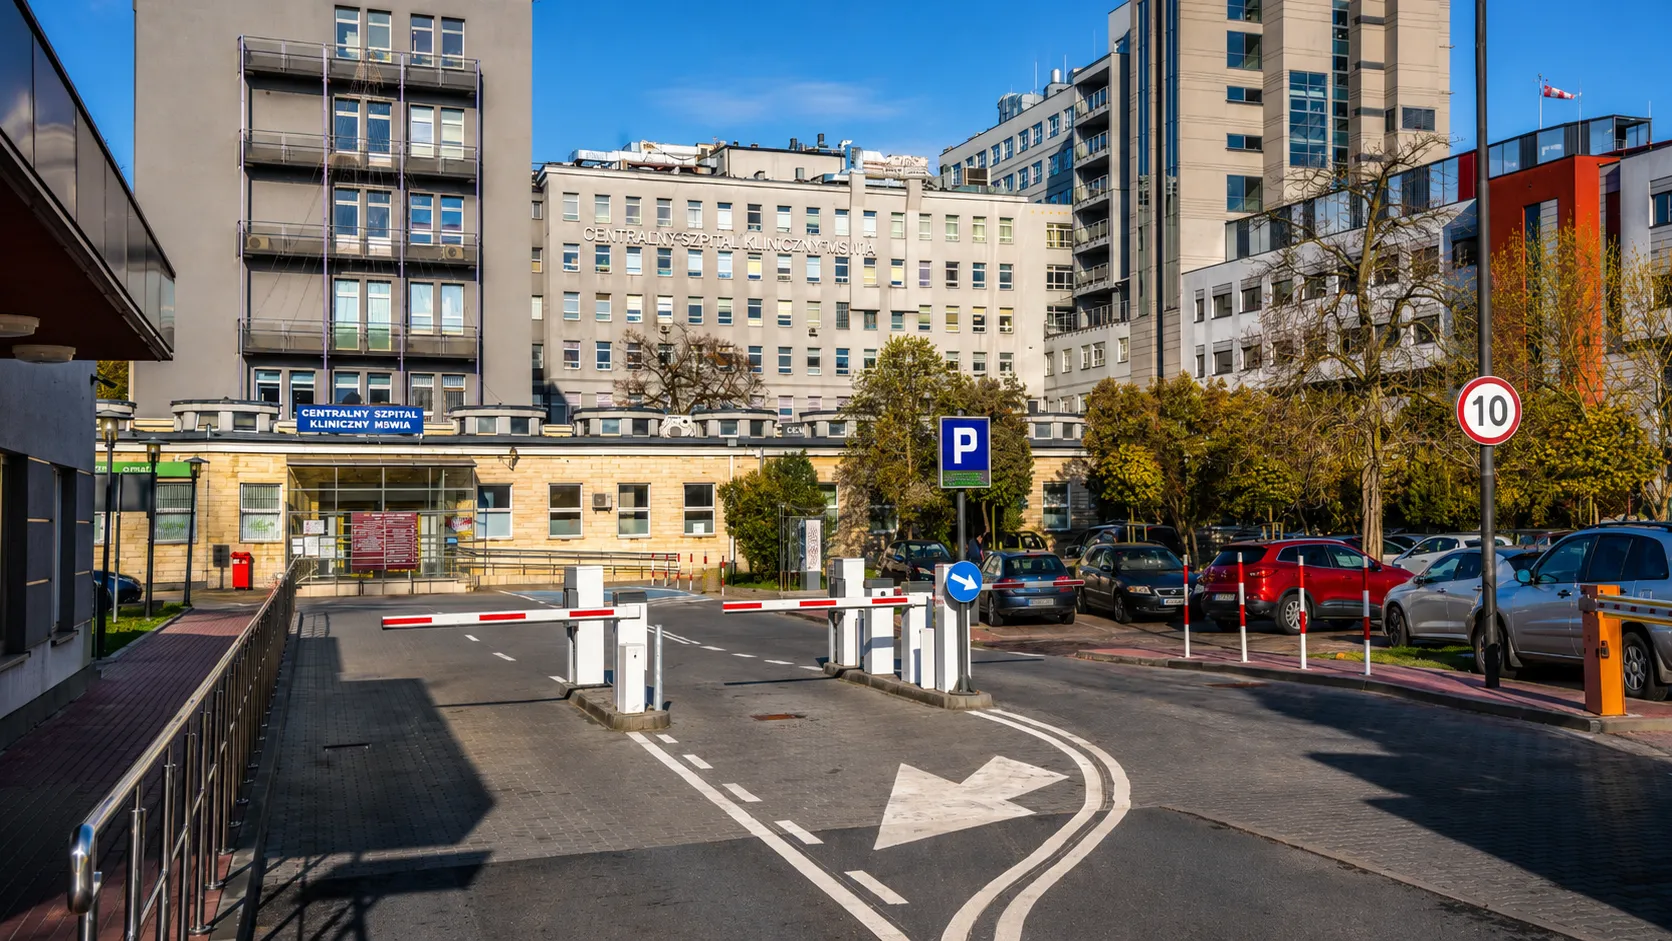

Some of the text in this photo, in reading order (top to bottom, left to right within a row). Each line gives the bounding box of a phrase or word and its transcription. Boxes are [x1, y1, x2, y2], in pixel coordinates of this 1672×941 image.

[583, 226, 677, 246] CENTRALNY
[681, 232, 739, 250] SZPITAL
[744, 236, 820, 254] KLINICZNY
[301, 409, 418, 419] CENTRALNY SZPITAL
[310, 420, 369, 429] KLINICZNY
[1472, 394, 1508, 427] 10
[953, 427, 978, 464] P
